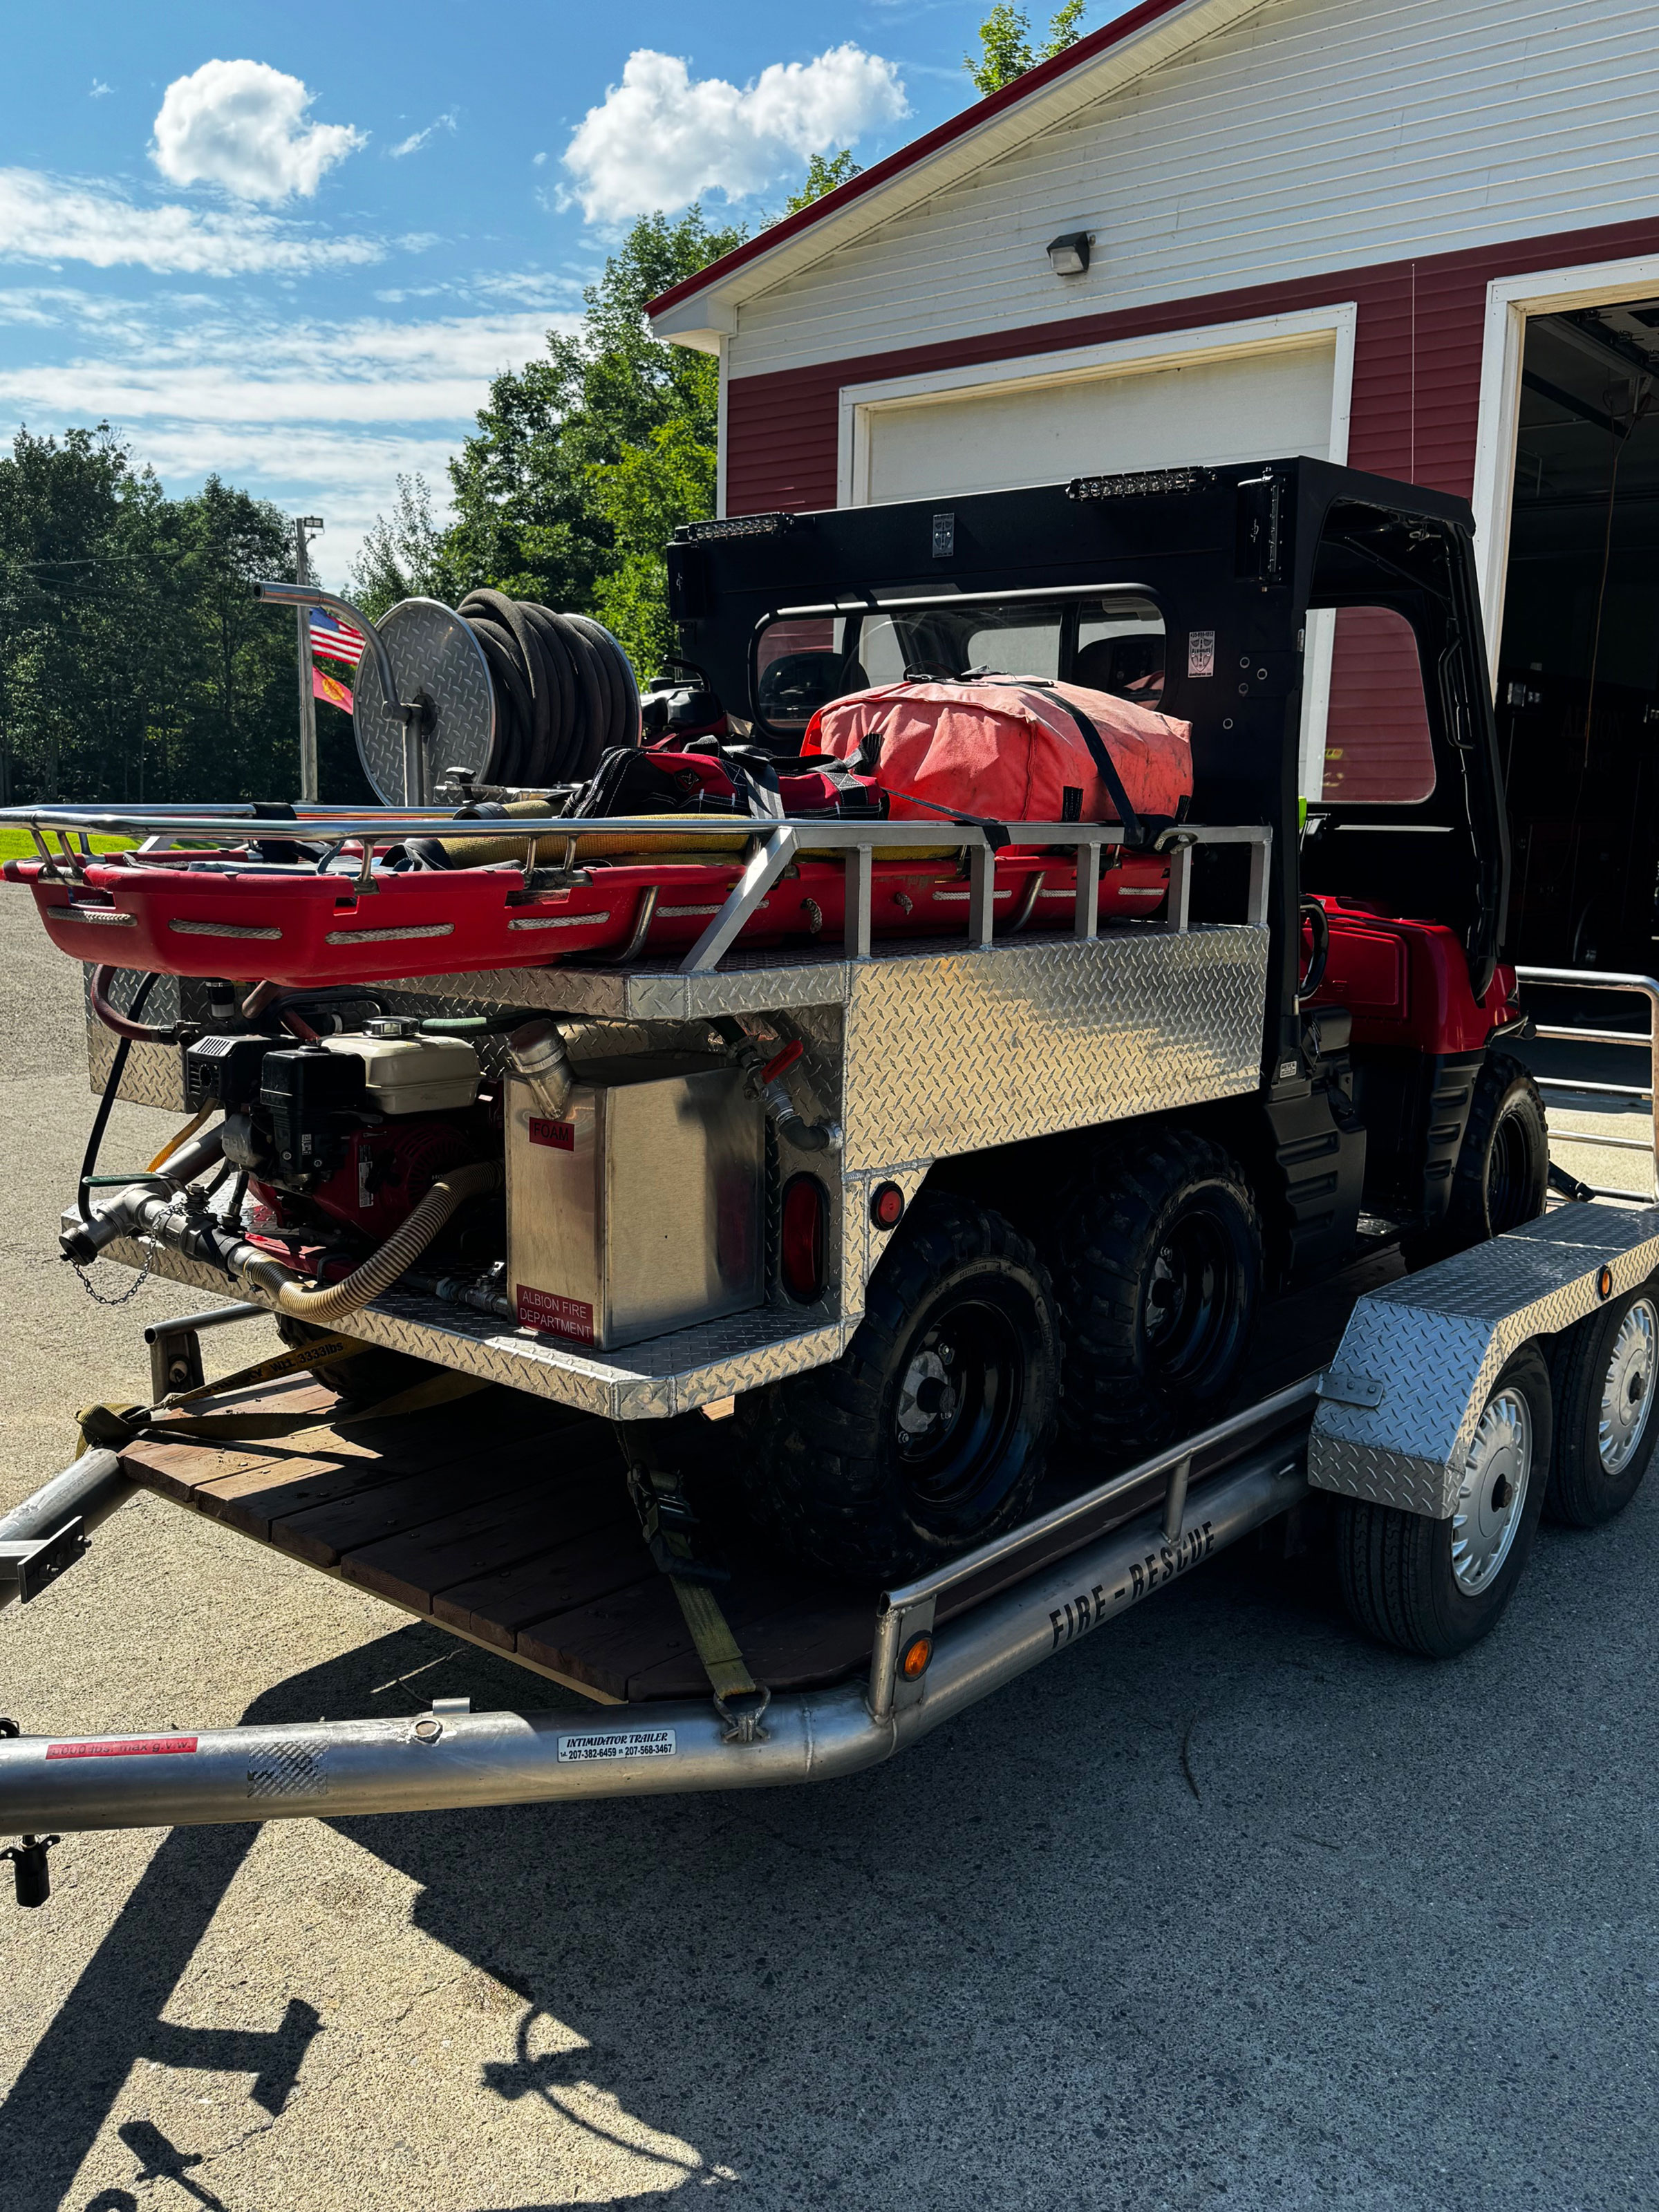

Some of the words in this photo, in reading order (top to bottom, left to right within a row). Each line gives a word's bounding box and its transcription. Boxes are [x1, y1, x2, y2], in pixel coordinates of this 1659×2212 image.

[534, 1123, 568, 1141] FOAM
[523, 1291, 559, 1311] ALBION
[562, 1301, 587, 1319] FIRE
[520, 1308, 591, 1338] DEPARTMENT
[1049, 1584, 1106, 1649] FIRE
[1129, 1521, 1215, 1601] RESCUE
[120, 1741, 147, 1753] max
[152, 1741, 191, 1753] g.v.w.
[567, 1735, 627, 1747] INTIMIDATOR
[629, 1732, 668, 1743] TRAILER
[569, 1747, 617, 1760] 207-382-6459
[625, 1743, 672, 1756] 207-568-3467
